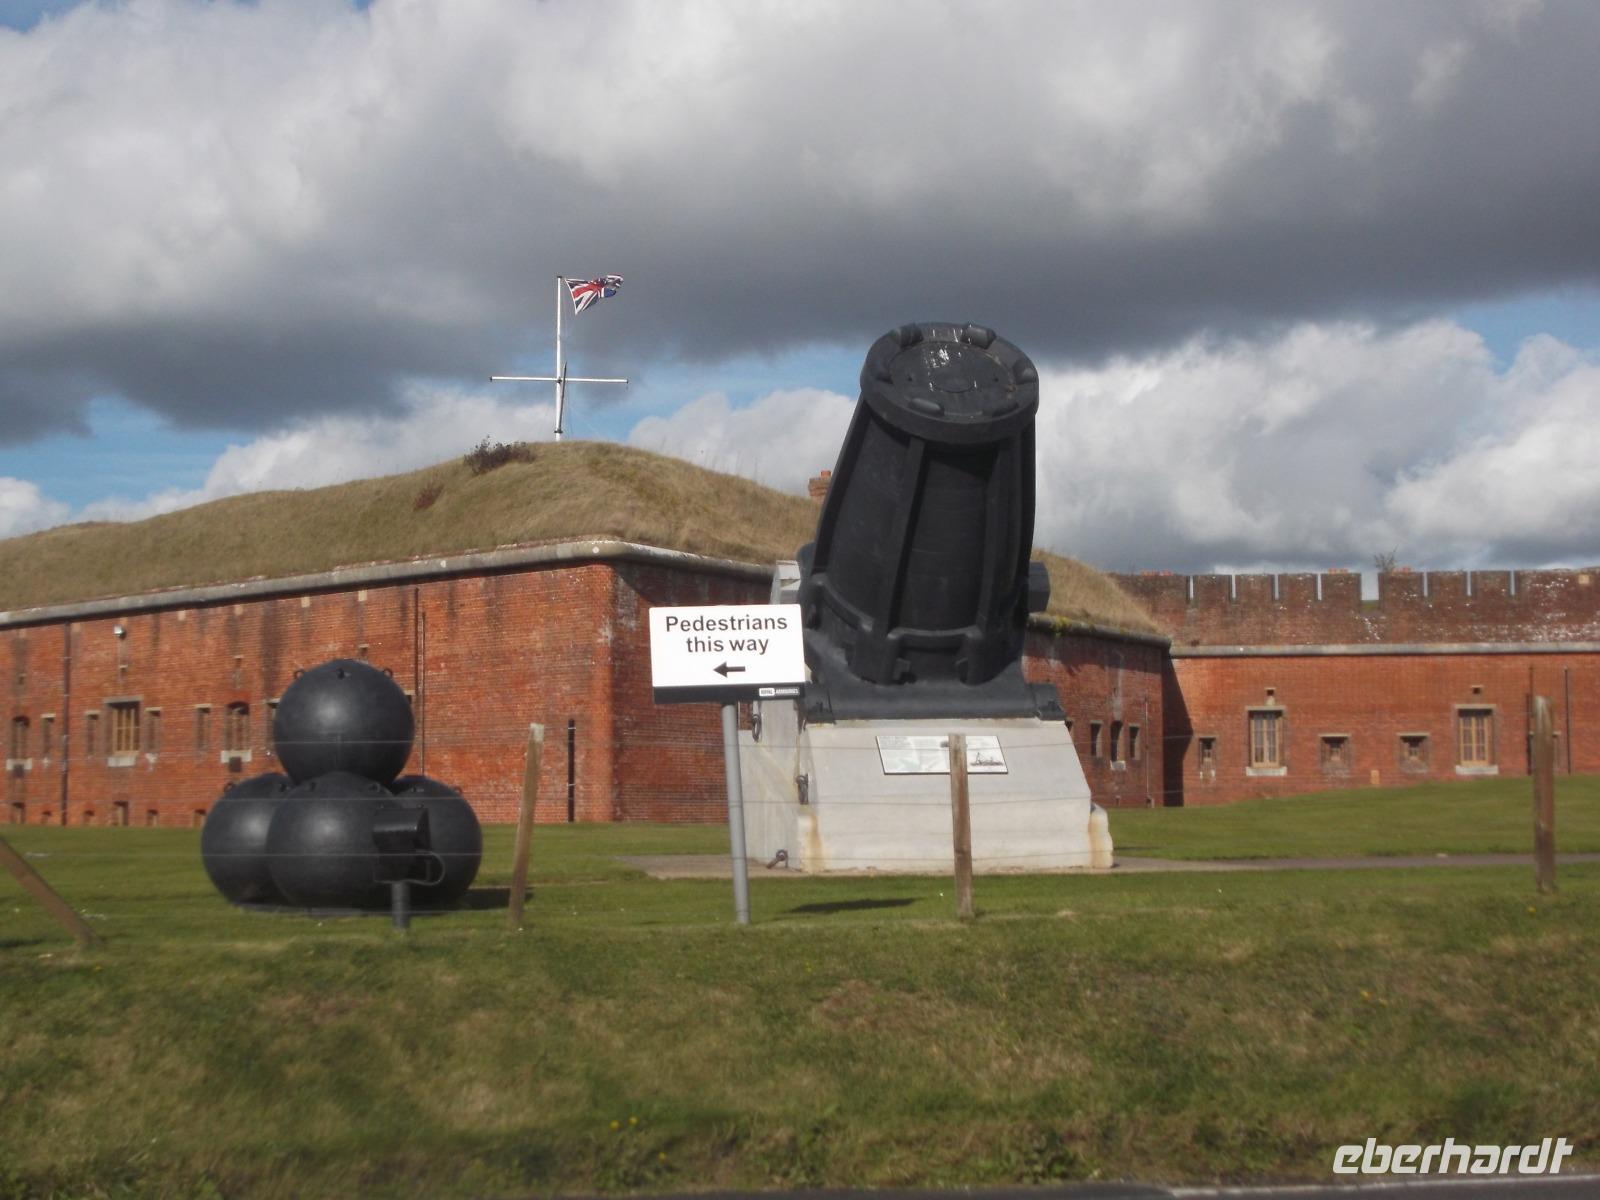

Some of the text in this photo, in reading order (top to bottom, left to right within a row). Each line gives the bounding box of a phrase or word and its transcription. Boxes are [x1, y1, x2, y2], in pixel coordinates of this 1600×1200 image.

[666, 614, 788, 632] Pedestrians
[686, 636, 769, 655] this way
